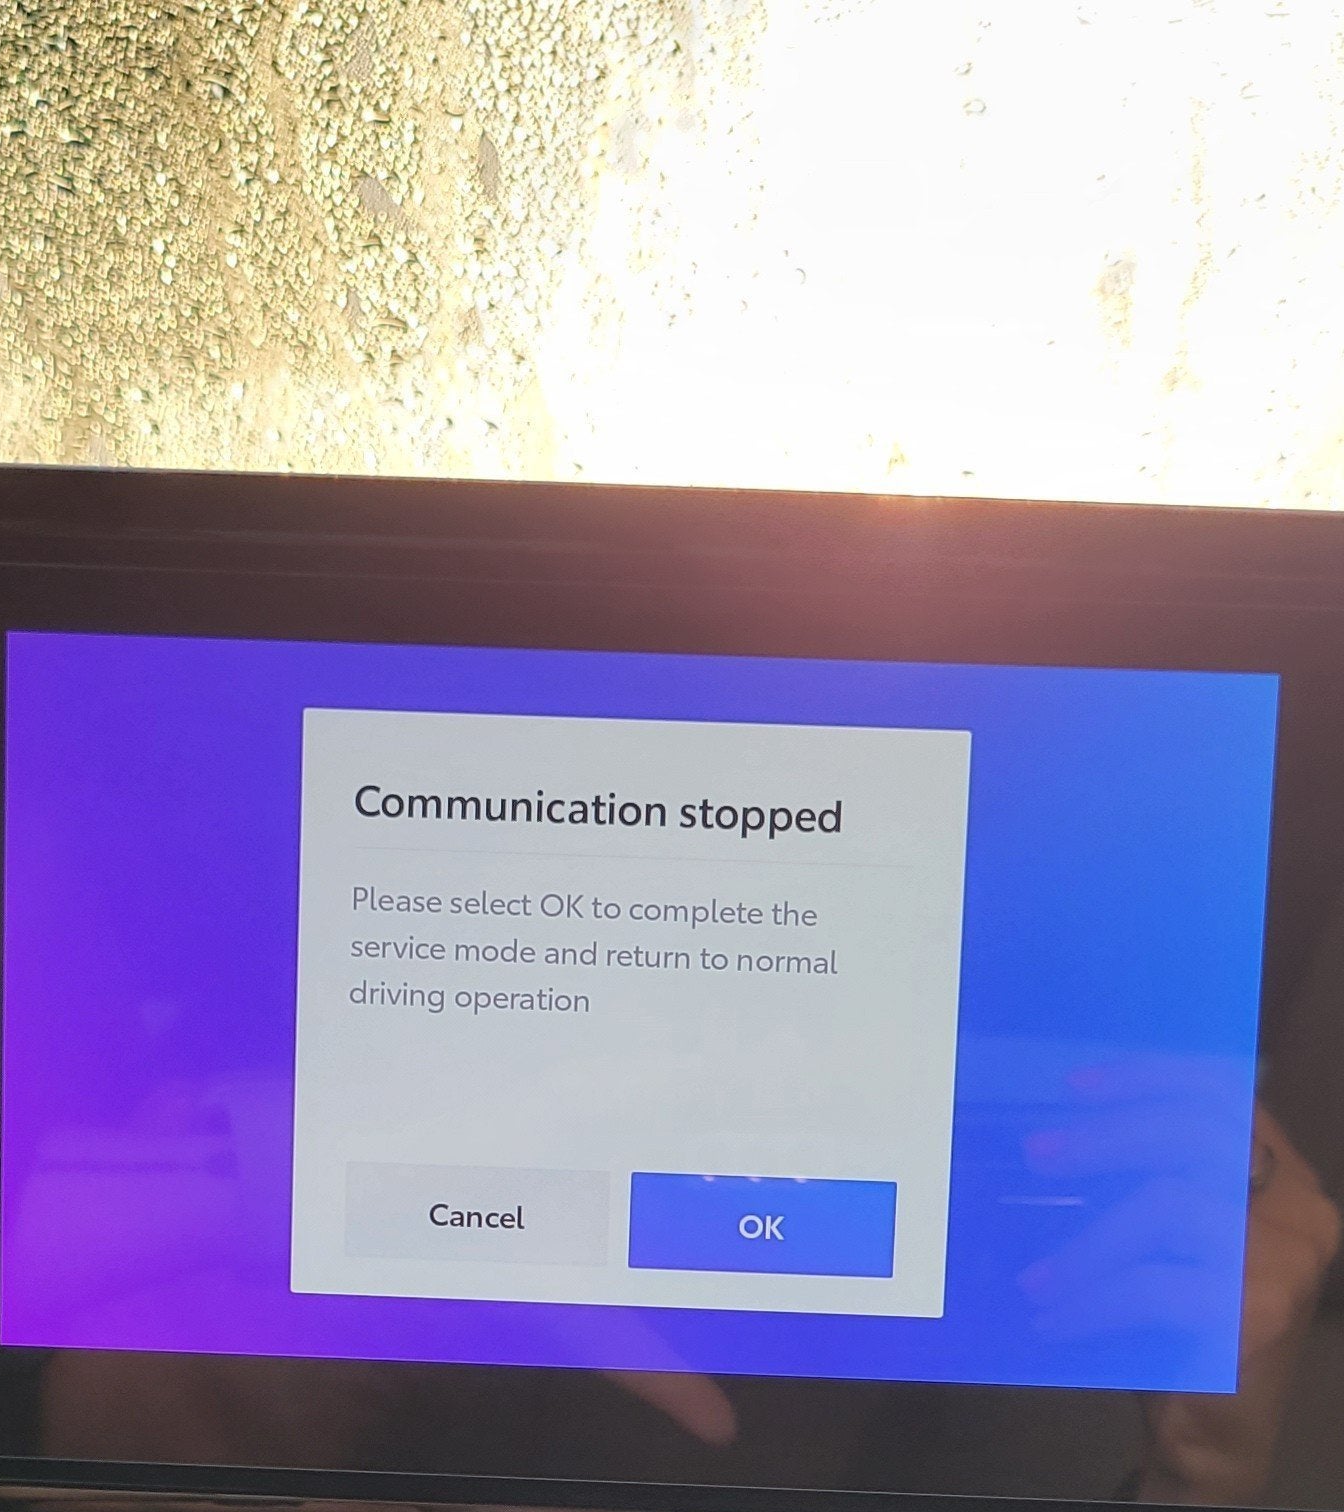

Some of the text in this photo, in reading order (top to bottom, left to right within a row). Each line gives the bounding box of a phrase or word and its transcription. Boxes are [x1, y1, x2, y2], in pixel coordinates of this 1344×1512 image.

[354, 785, 843, 840] Communication stopped
[352, 887, 818, 930] Please select OK to complete the
[350, 935, 839, 975] service mode and return to normal
[349, 980, 591, 1016] driving operation
[429, 1202, 524, 1231] Cancel
[738, 1213, 785, 1241] OK
